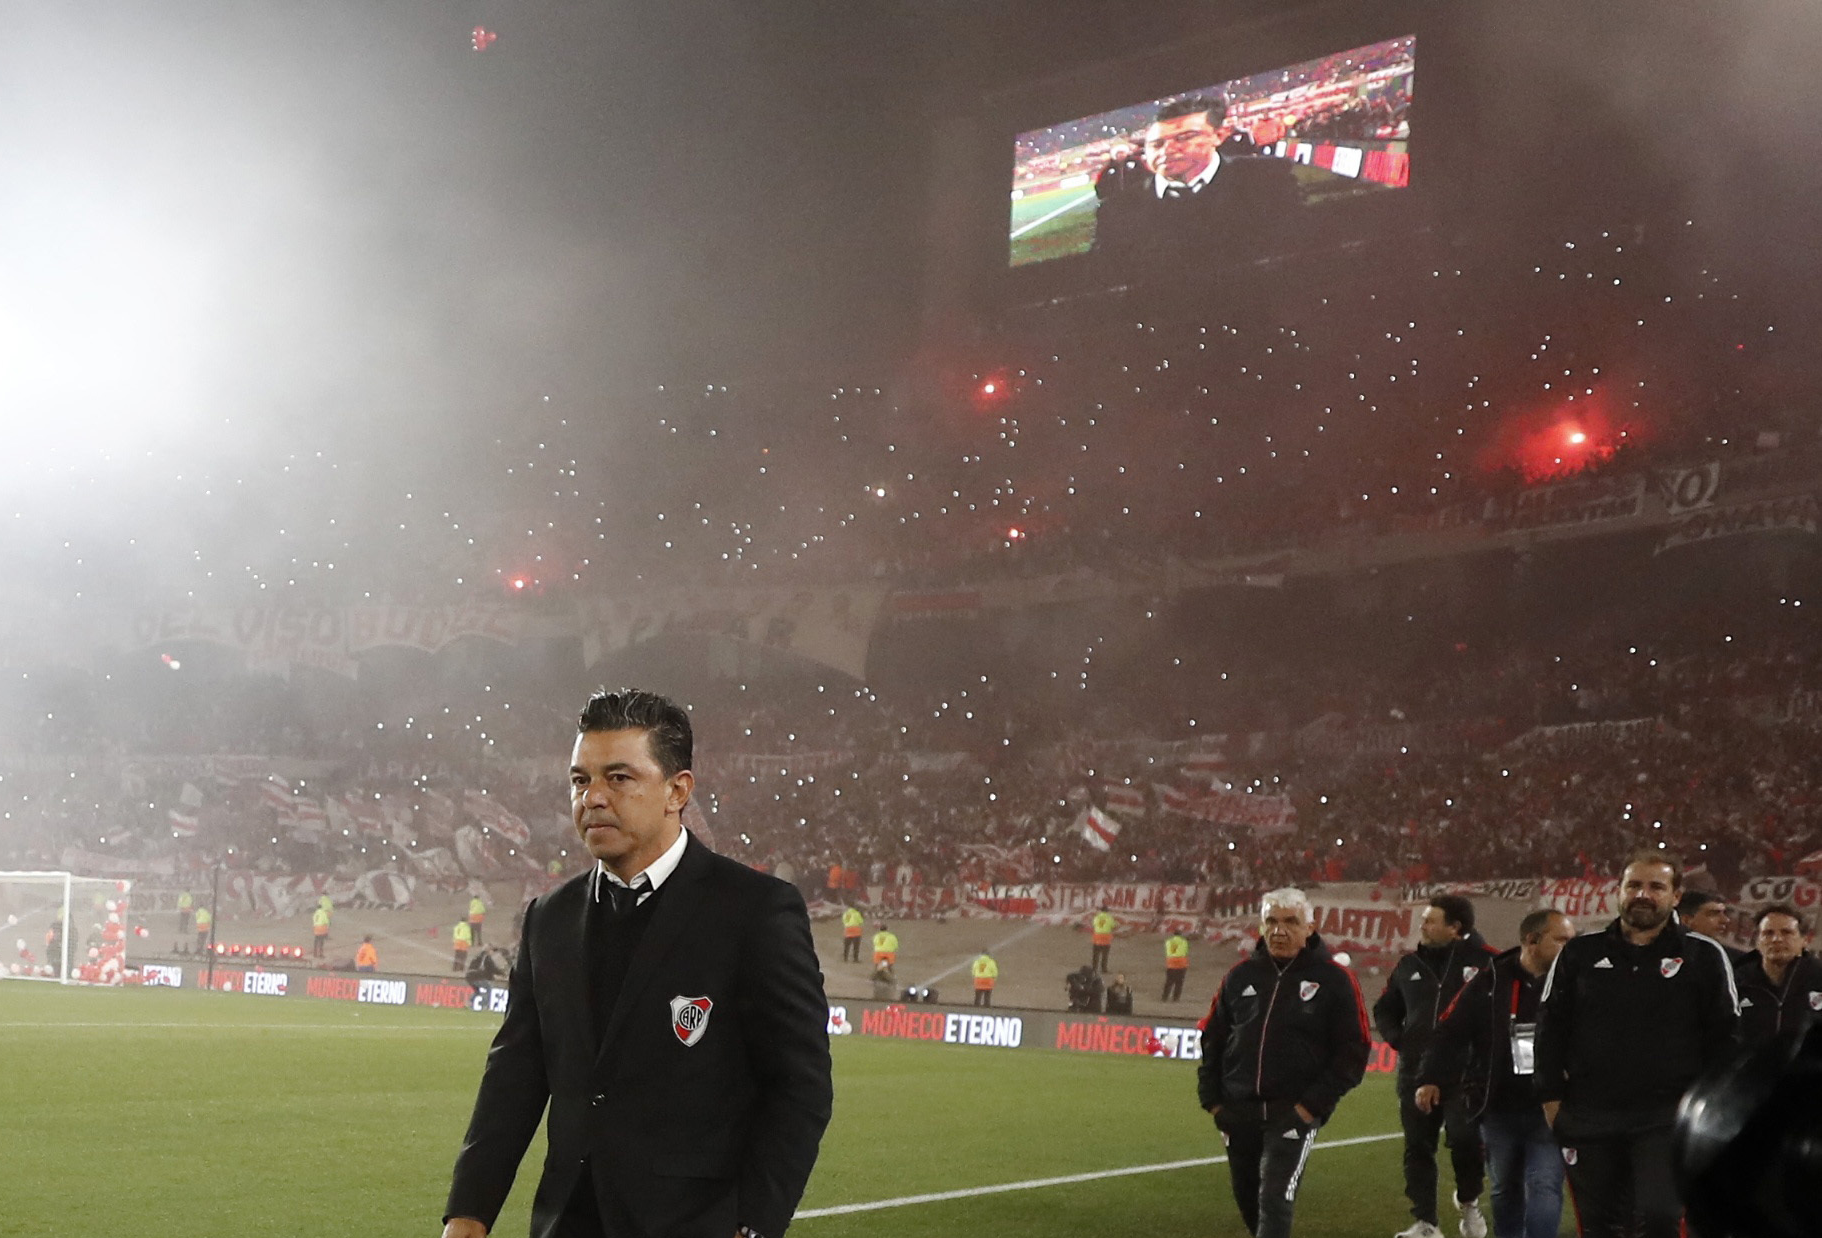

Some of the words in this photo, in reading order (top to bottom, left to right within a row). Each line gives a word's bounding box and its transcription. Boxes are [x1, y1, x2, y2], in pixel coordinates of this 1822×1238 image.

[861, 1004, 945, 1040] MUÑECO
[945, 1014, 1023, 1047] ETERNO
[1056, 1015, 1154, 1055] MUÑECO
